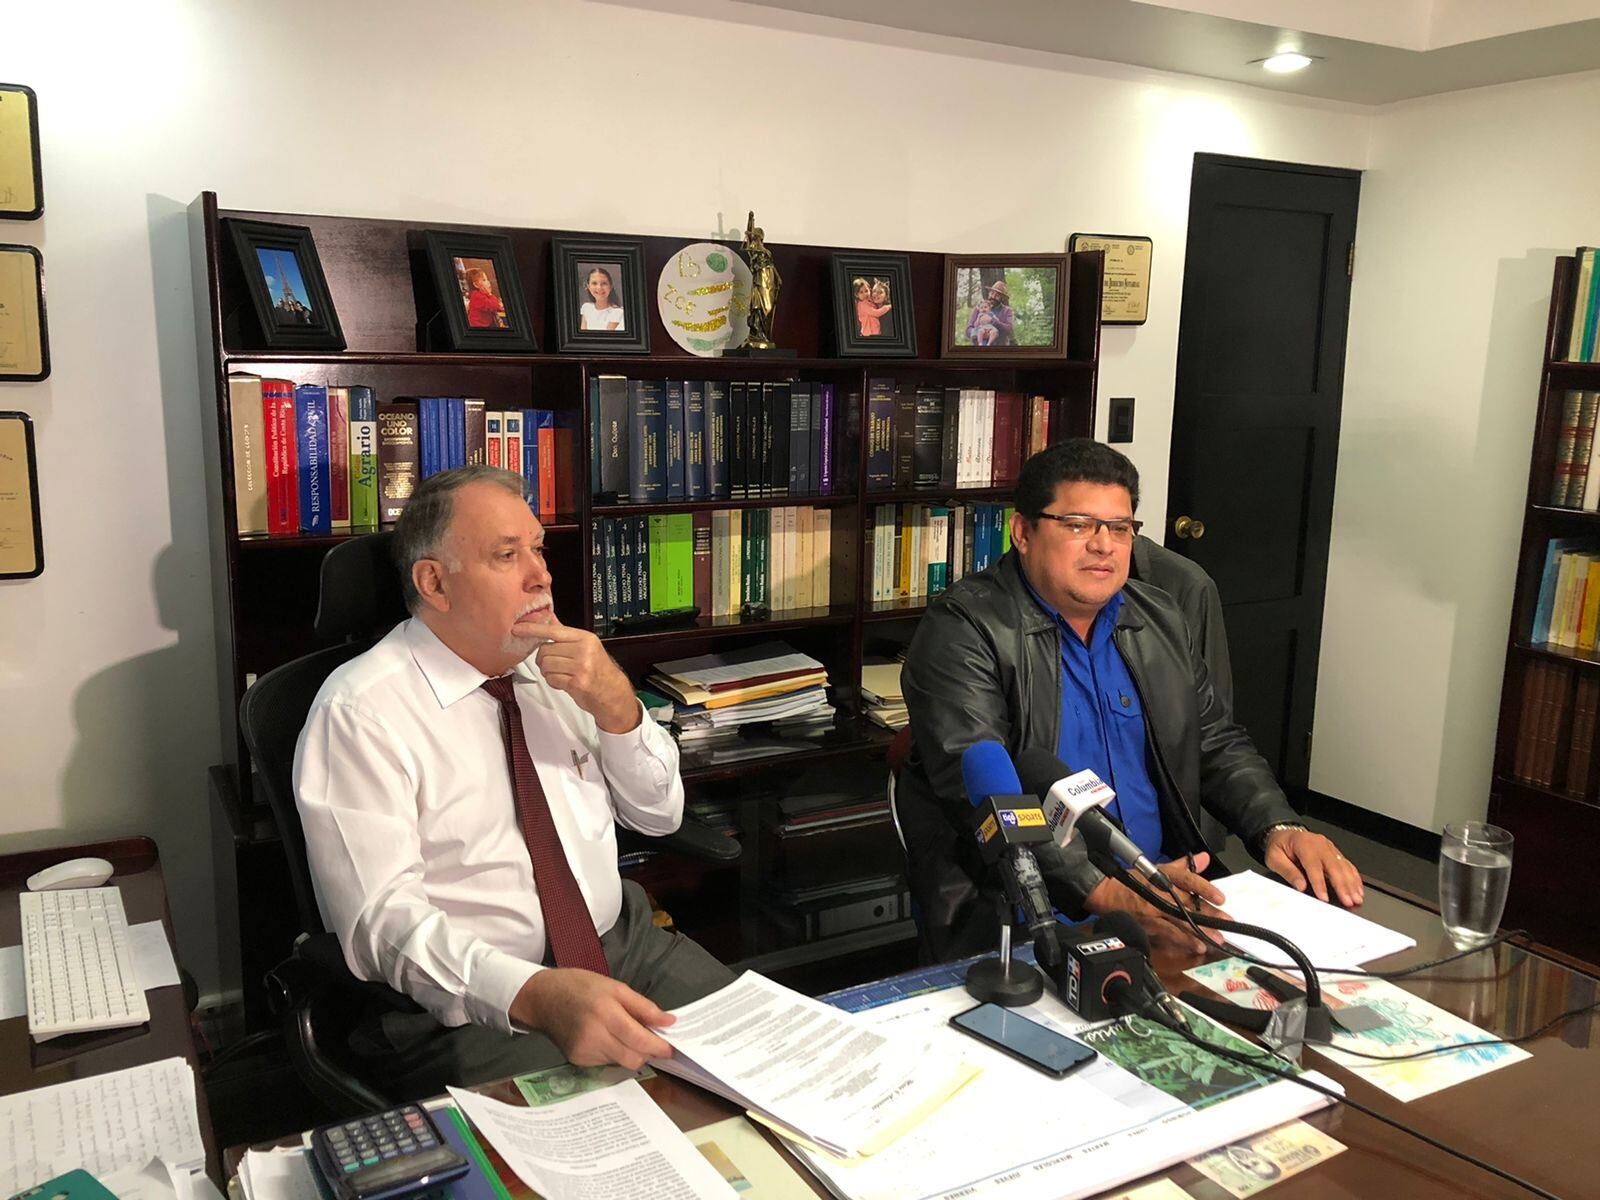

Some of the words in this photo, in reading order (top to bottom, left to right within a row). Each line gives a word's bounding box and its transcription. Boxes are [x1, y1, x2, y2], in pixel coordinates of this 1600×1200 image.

[307, 400, 318, 426] CVIL
[281, 437, 287, 445] de
[381, 427, 413, 435] COLOR
[281, 446, 289, 474] República
[357, 426, 376, 488] Agrario
[306, 427, 320, 512] RESPONSABILIDAD
[593, 522, 597, 530] 2
[1068, 778, 1105, 797] Columbia
[1018, 813, 1043, 822] SPORTS
[1050, 801, 1066, 832] olumbia
